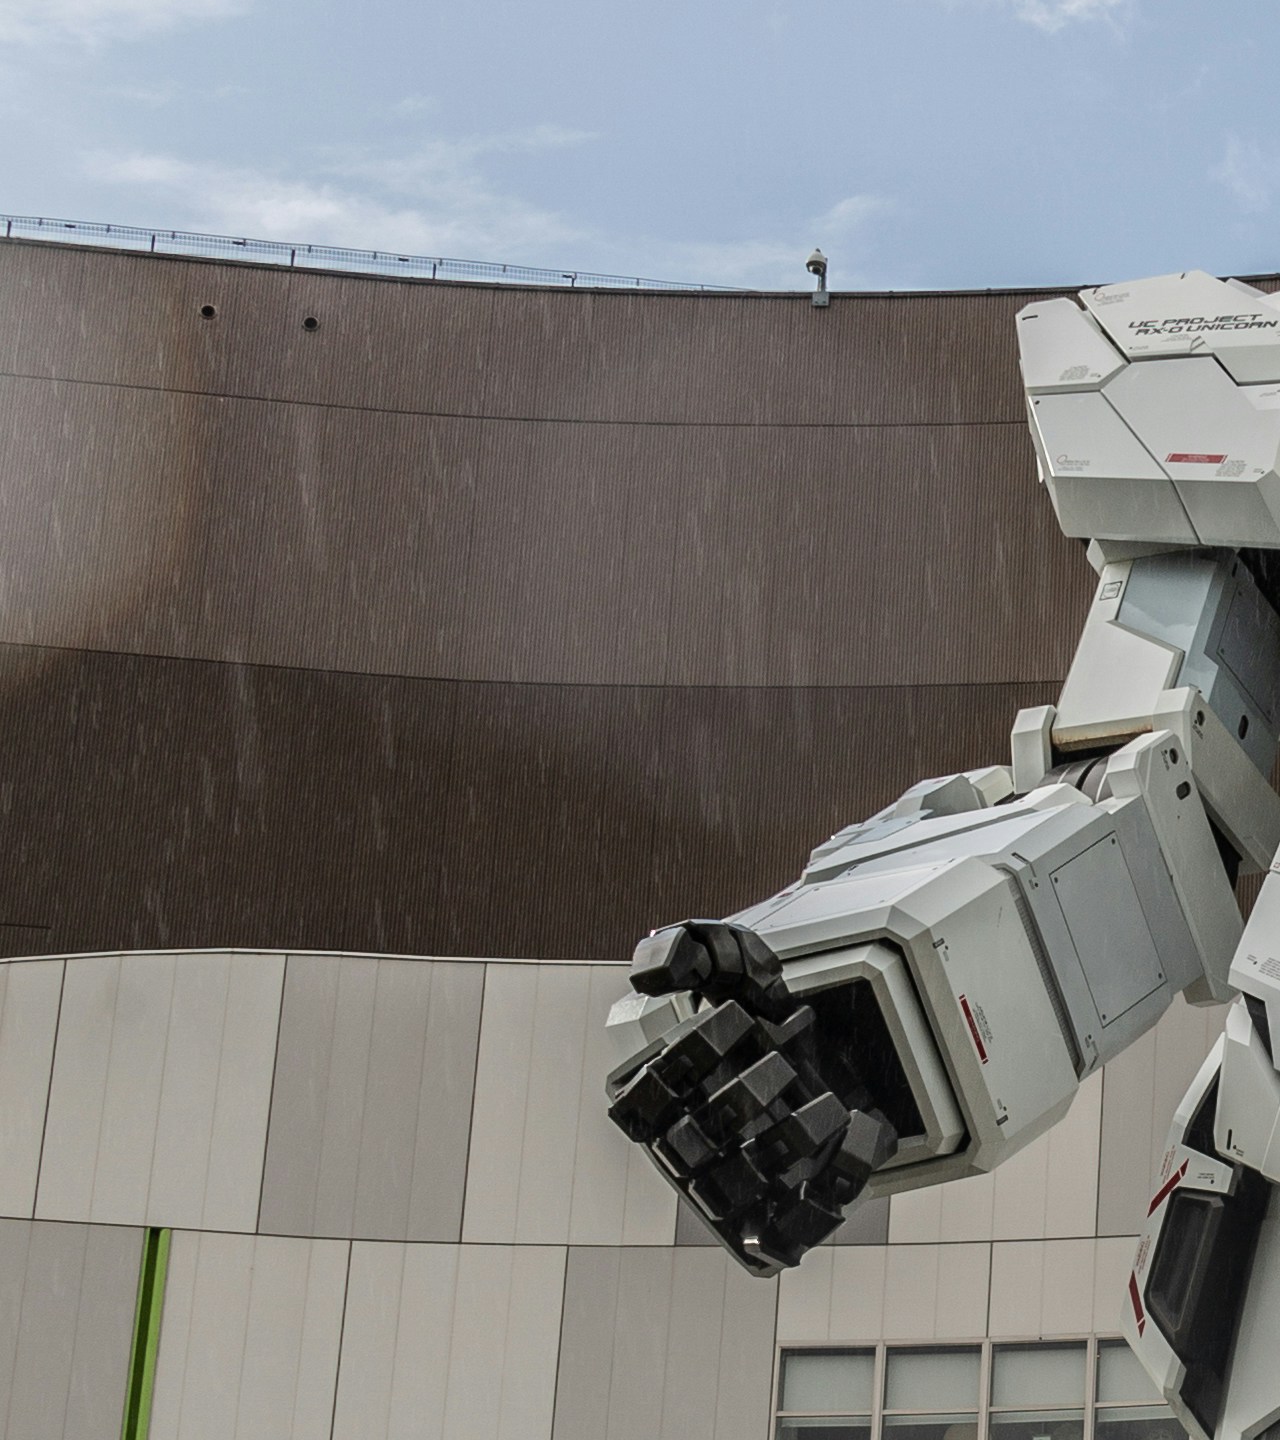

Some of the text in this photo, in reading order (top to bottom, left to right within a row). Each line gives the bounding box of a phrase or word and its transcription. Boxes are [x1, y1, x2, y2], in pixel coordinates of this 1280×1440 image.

[1128, 313, 1263, 329] UC PROJECT
[1186, 320, 1279, 333] UNICORN
